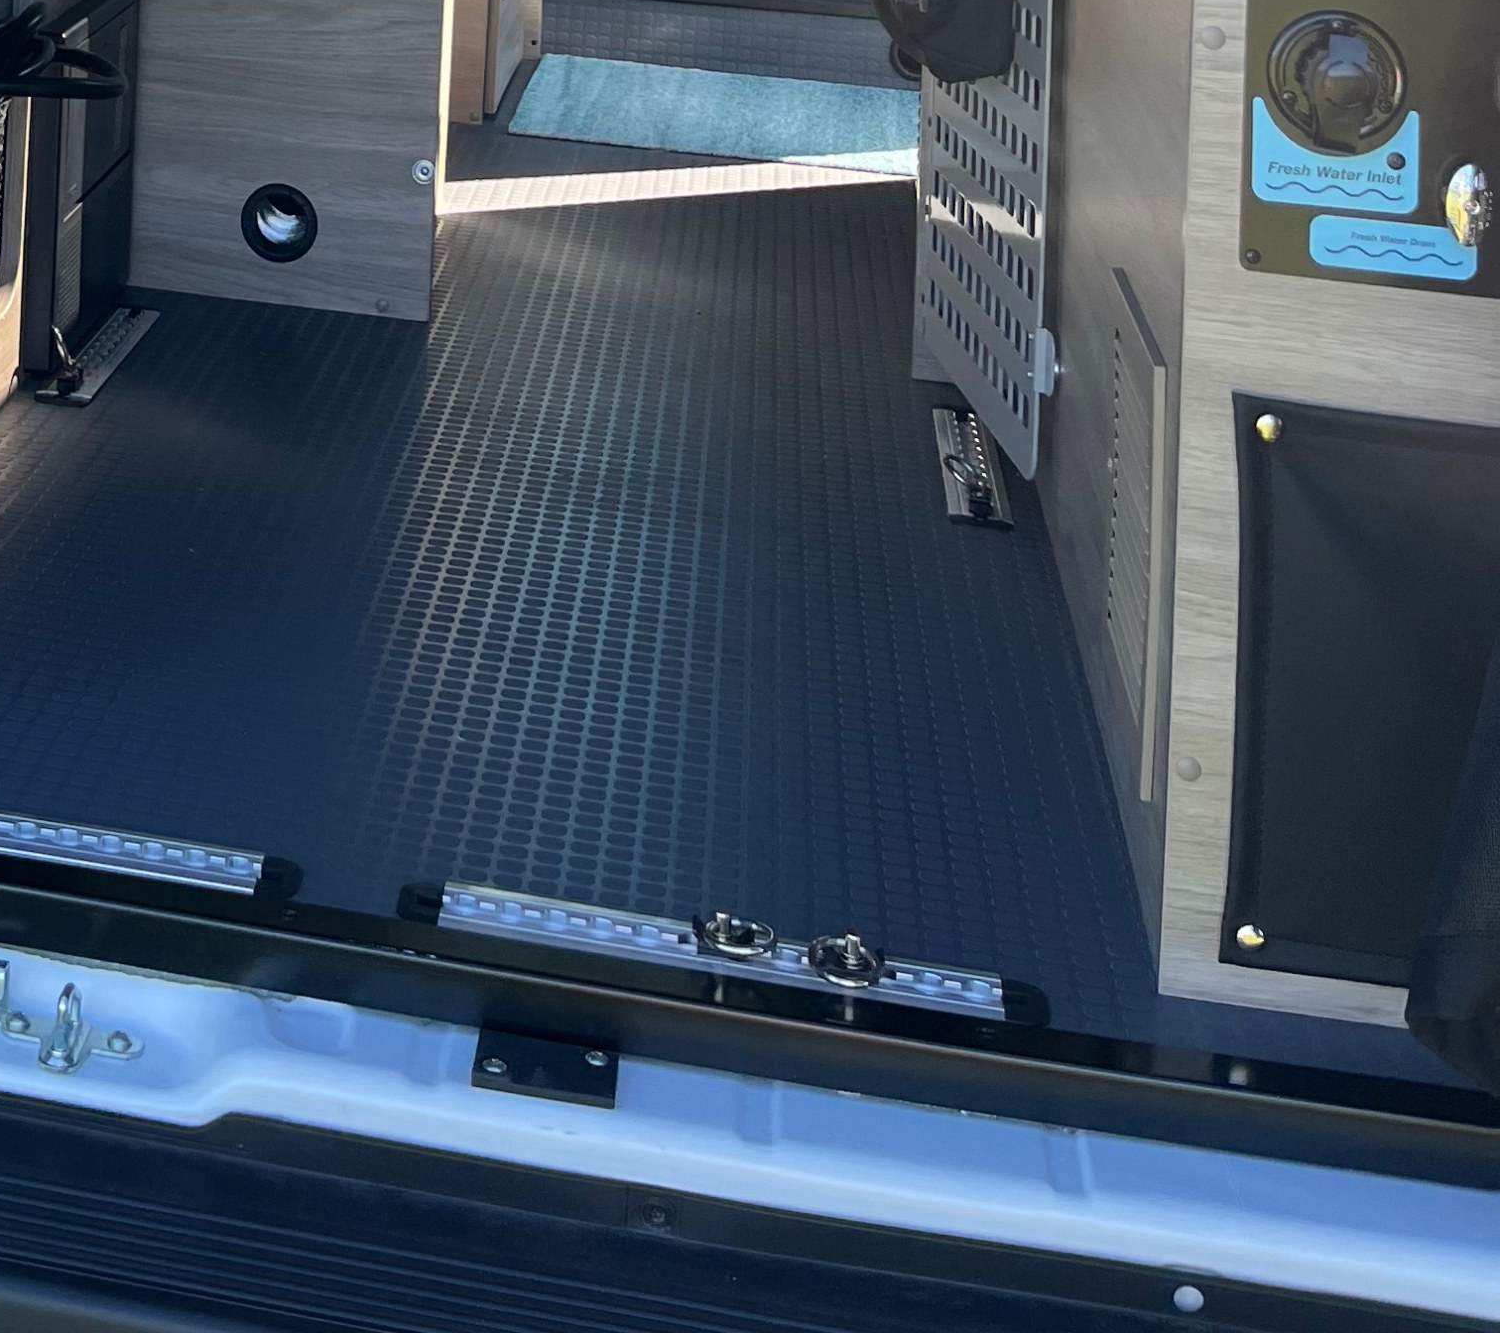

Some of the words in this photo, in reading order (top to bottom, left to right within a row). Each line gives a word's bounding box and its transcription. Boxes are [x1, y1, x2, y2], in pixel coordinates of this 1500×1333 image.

[1268, 161, 1311, 177] Fresh
[1317, 166, 1363, 181] Water
[1367, 170, 1402, 185] Inlet
[1351, 232, 1377, 242] Fresh
[1380, 235, 1408, 245] Water
